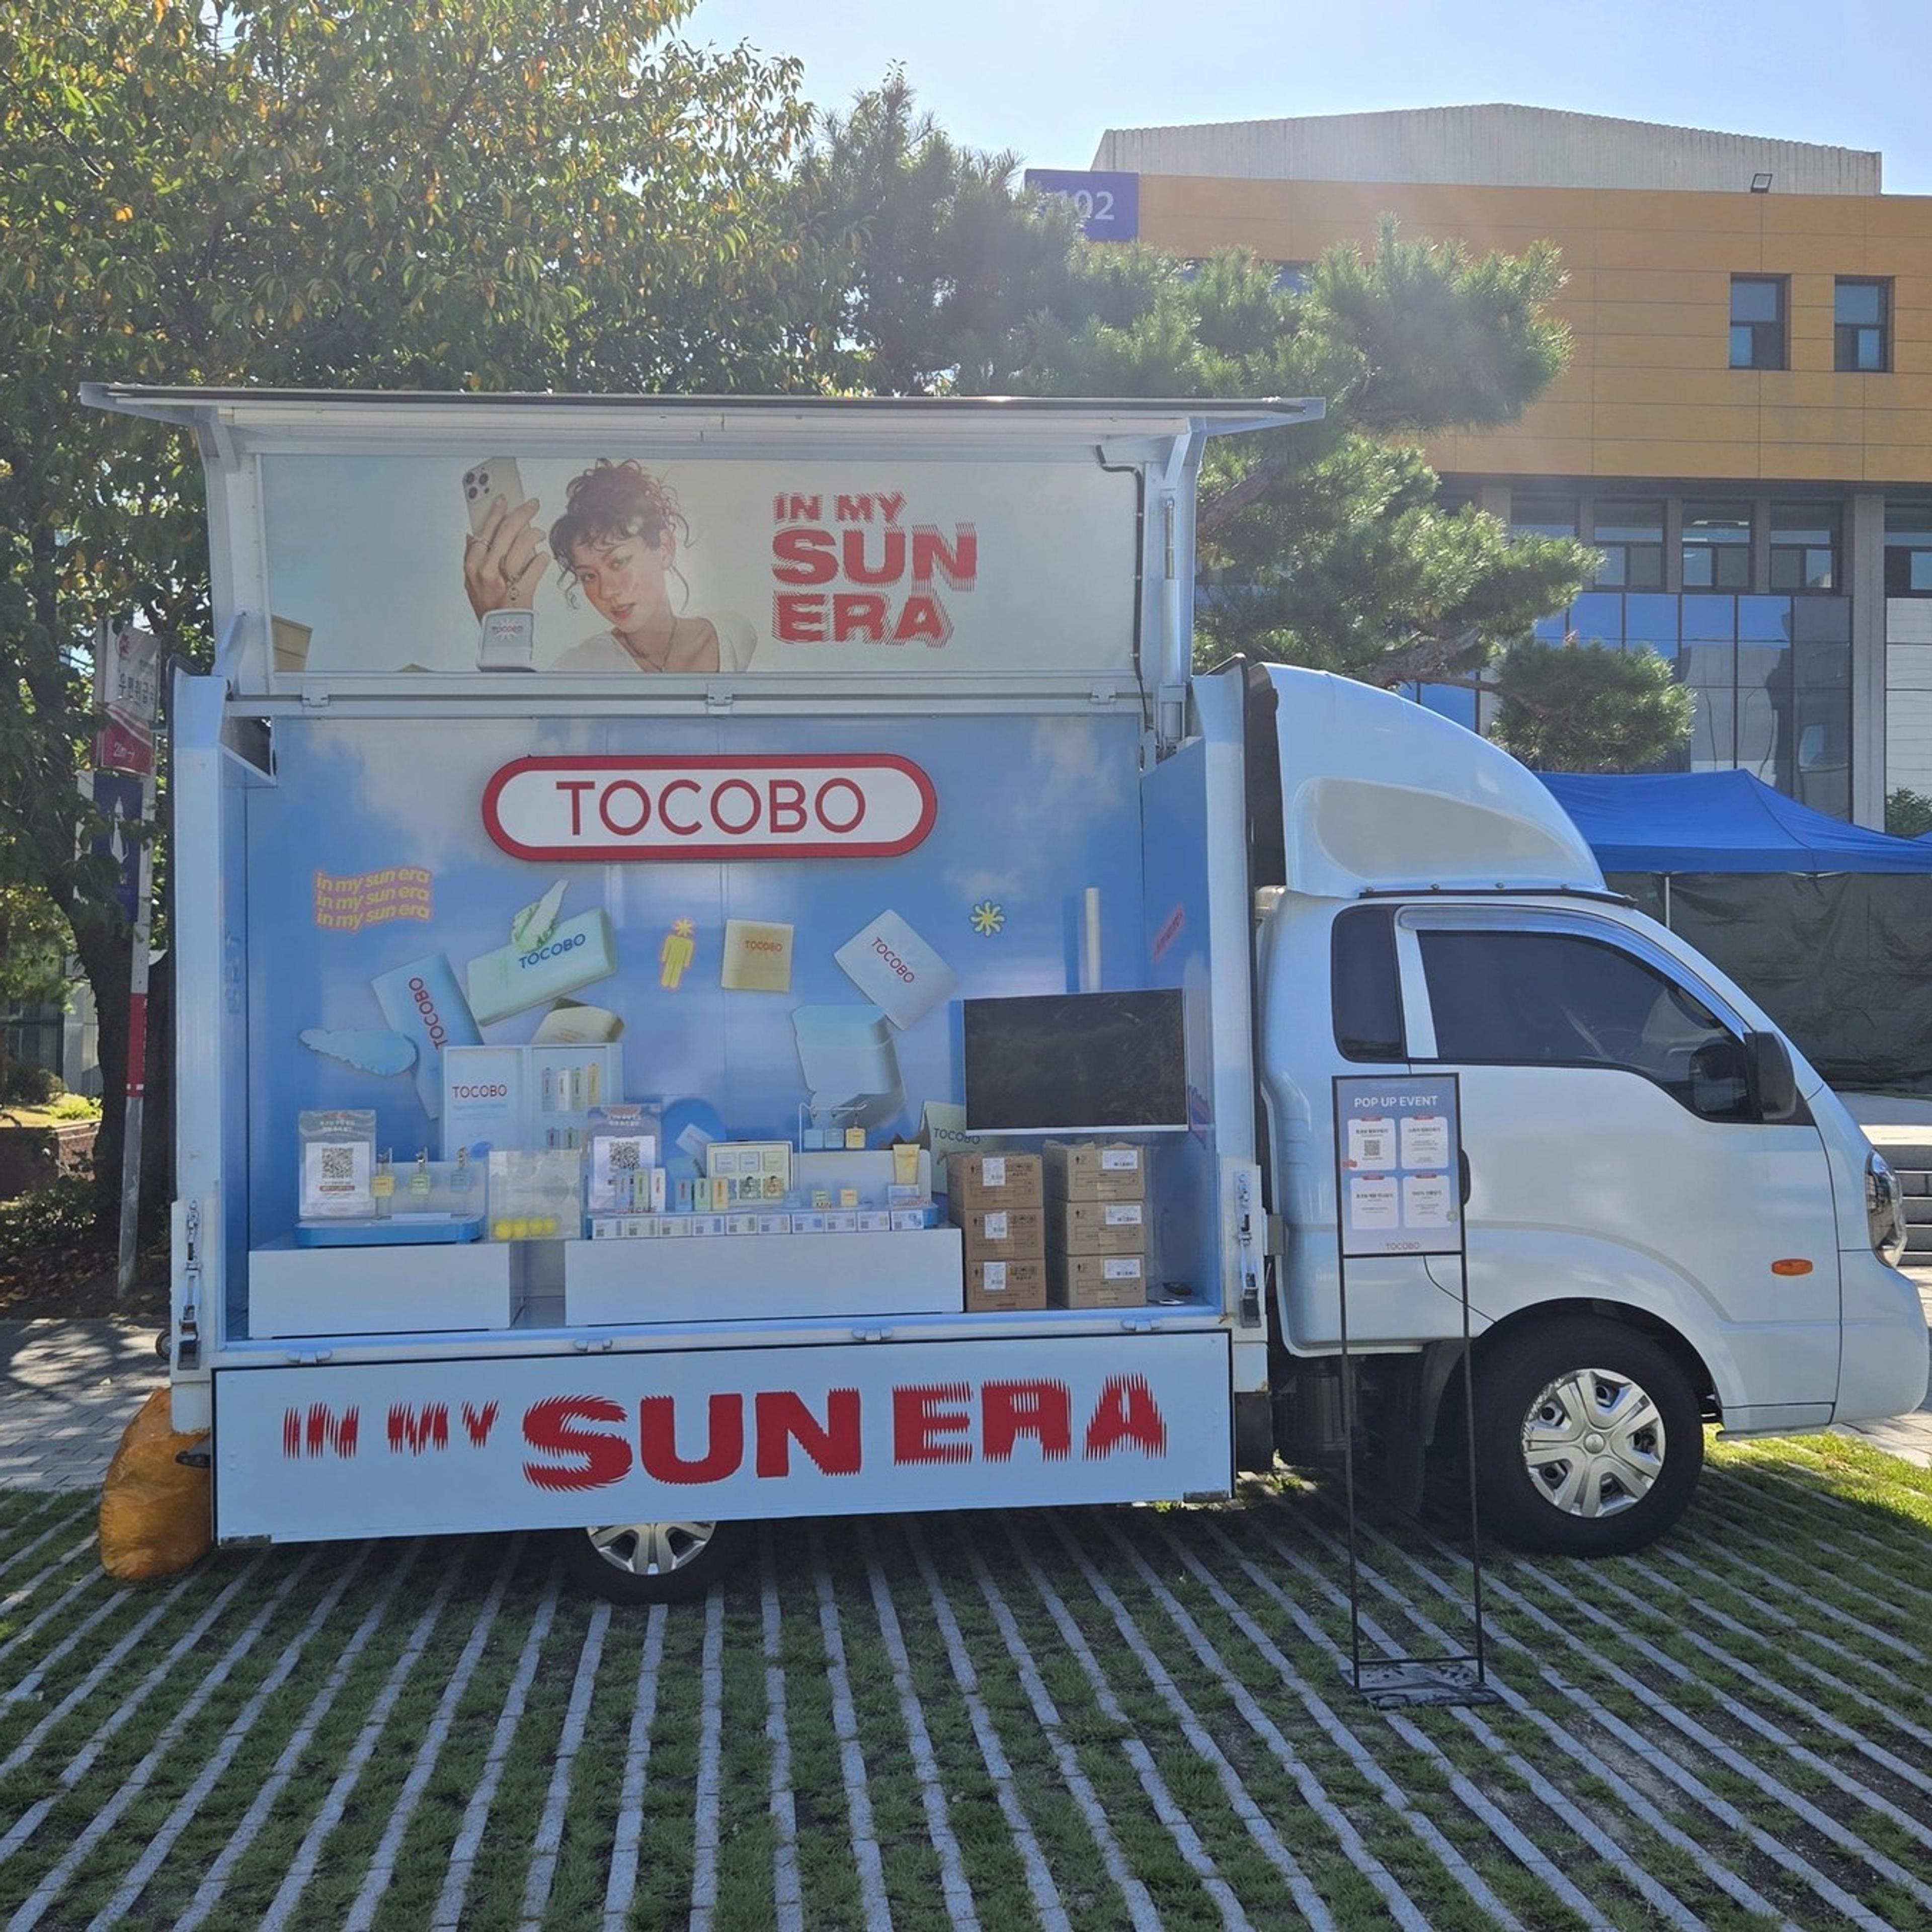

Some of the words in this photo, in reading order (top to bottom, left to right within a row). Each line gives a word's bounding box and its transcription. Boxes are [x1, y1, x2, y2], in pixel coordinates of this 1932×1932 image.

[771, 492, 823, 524] IN
[834, 490, 907, 523] MY
[771, 522, 977, 591] SUN
[772, 590, 954, 648] ERA
[556, 777, 866, 836] TOCOBO
[316, 872, 333, 891] in
[336, 878, 364, 894] my
[365, 870, 395, 888] sun
[398, 869, 430, 883] era
[316, 891, 333, 908] in
[336, 896, 364, 912] my
[365, 888, 395, 905] sun
[397, 887, 430, 901] era
[316, 908, 333, 925] in
[336, 912, 364, 930] my
[365, 906, 395, 922] sun
[398, 904, 430, 920] era
[519, 934, 586, 969] TOCOBO
[744, 940, 783, 952] TOCOBO
[871, 937, 915, 984] TOCOBO
[409, 978, 448, 1050] TOCOBO
[452, 1084, 507, 1099] TOCOBO
[1354, 1097, 1380, 1108] POP
[1381, 1096, 1397, 1107] UP
[1399, 1095, 1438, 1106] EVENT
[1386, 1242, 1420, 1251] TOCOBO
[283, 1401, 360, 1460] IN
[387, 1400, 500, 1457] MY
[522, 1387, 862, 1492] SUN
[892, 1371, 1168, 1467] ERA
